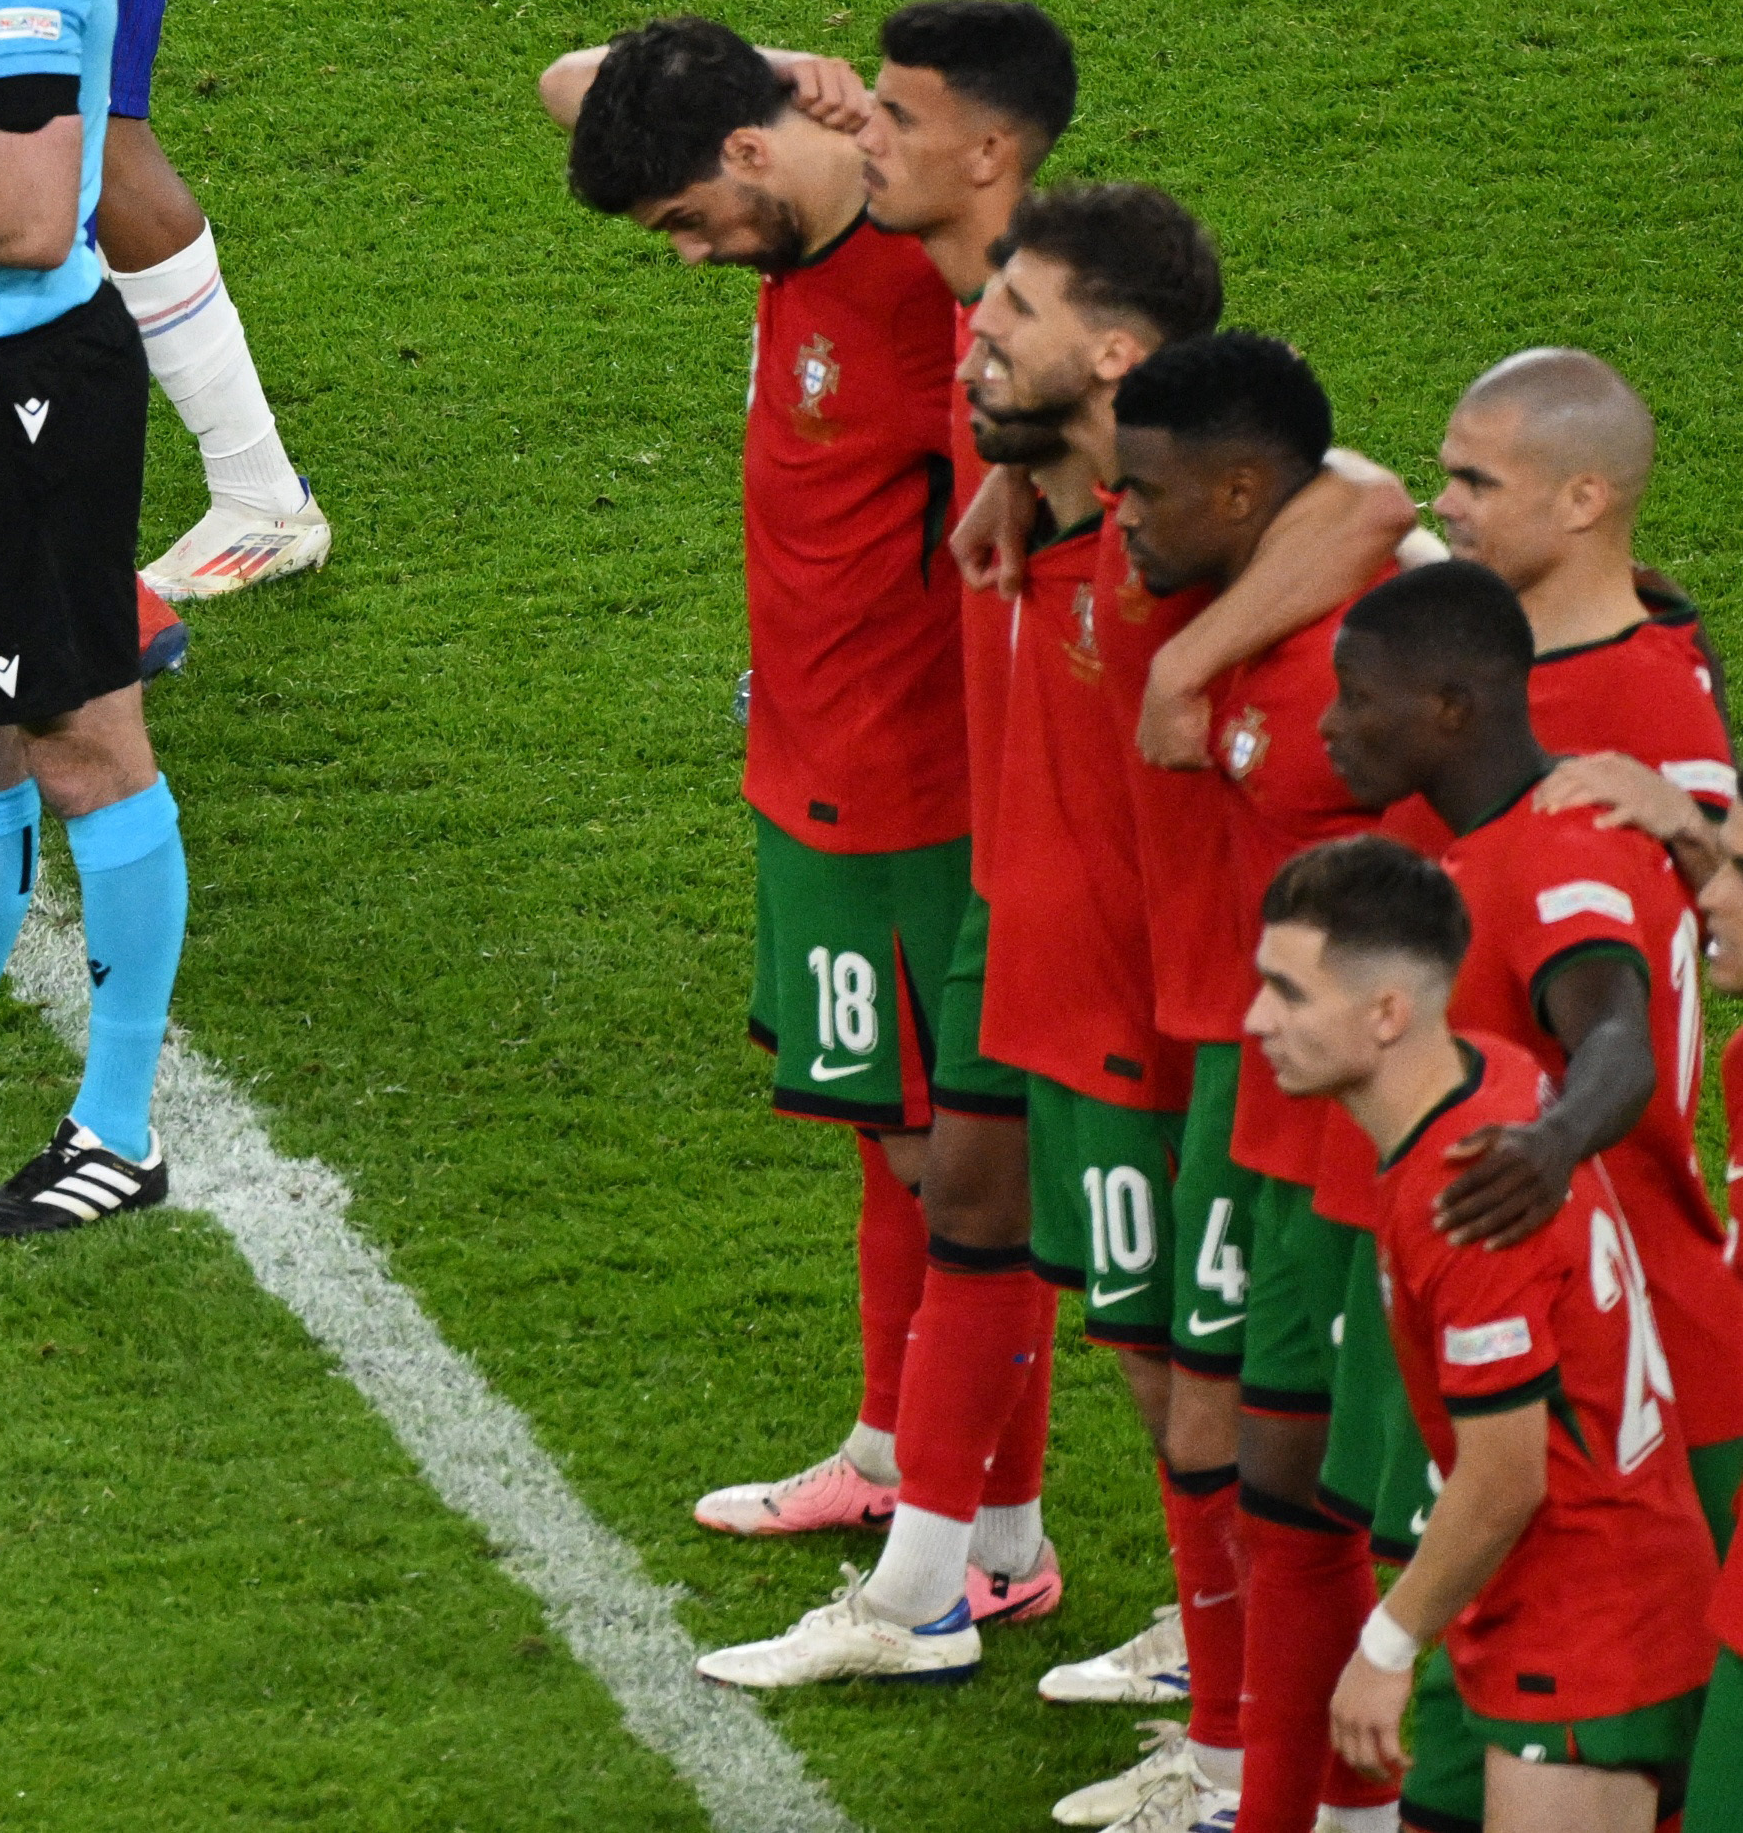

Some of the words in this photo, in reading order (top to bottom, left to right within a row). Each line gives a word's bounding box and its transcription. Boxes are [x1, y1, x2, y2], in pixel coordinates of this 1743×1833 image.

[807, 944, 879, 1055] 18
[1081, 1164, 1158, 1275] 10
[1194, 1197, 1250, 1304] 4
